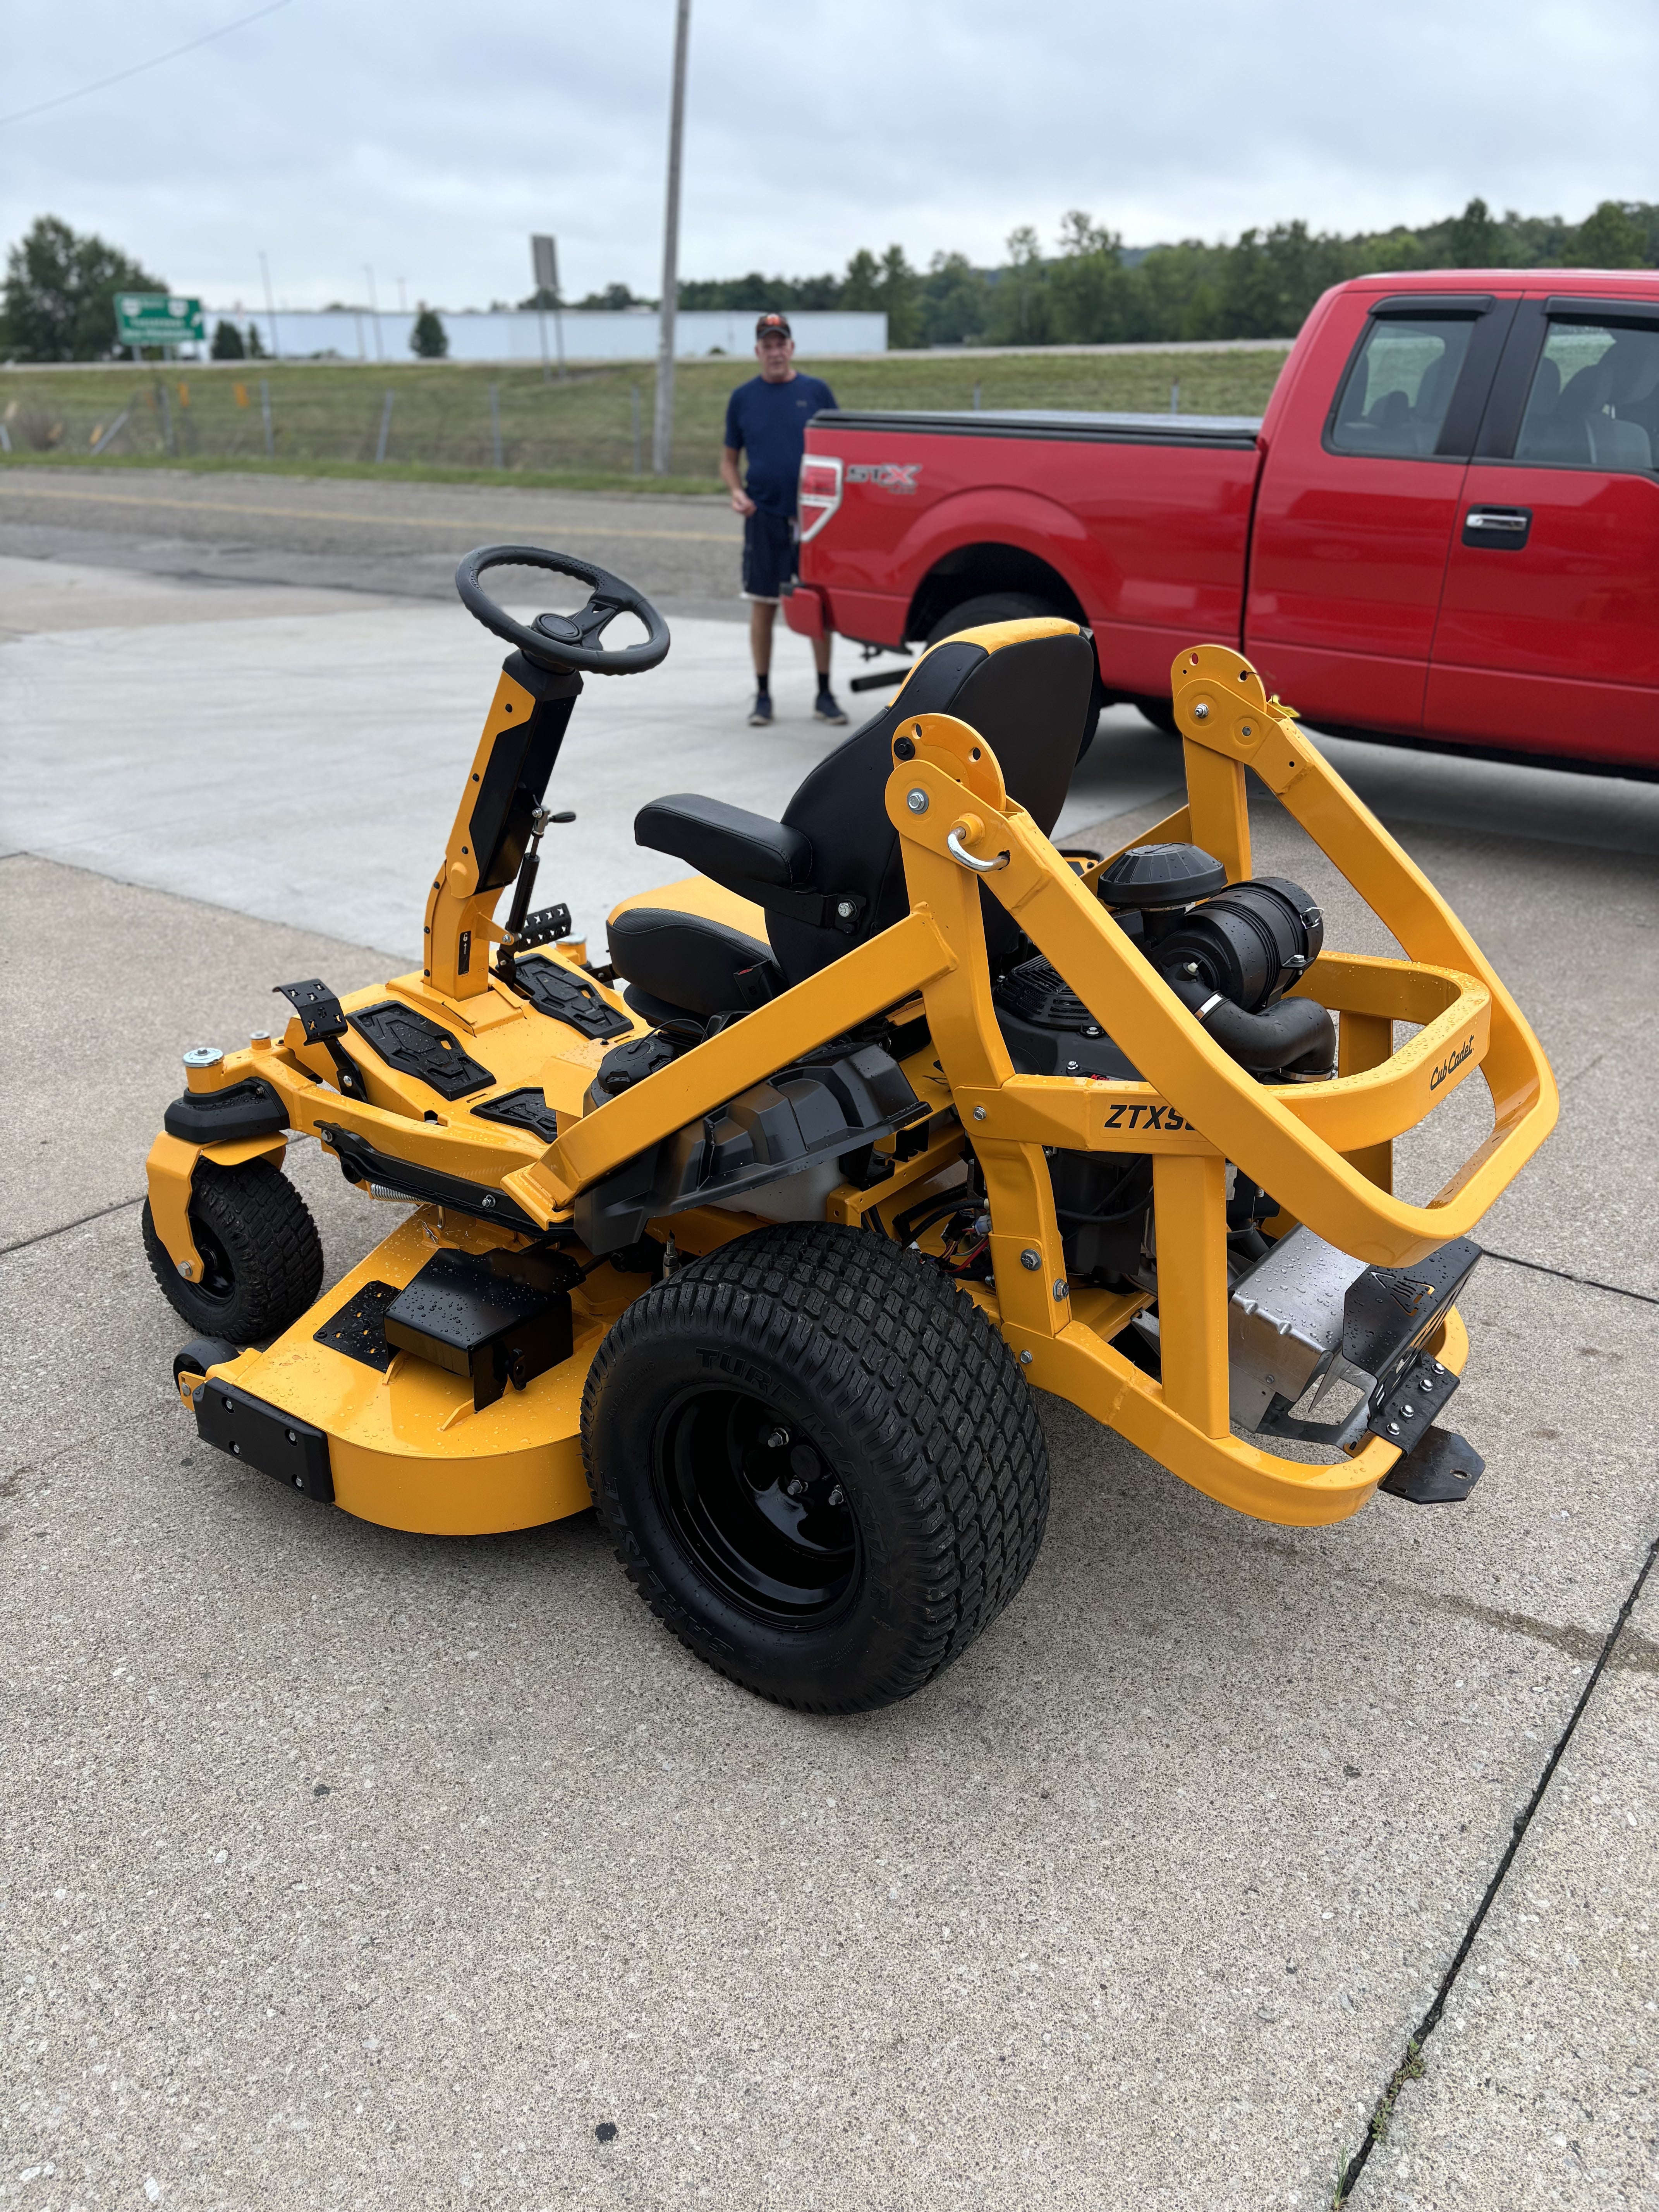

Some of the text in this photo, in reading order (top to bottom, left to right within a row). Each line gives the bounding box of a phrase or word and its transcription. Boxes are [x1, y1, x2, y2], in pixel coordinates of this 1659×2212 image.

[846, 464, 922, 487] STX
[1430, 1035, 1474, 1091] Cub Cadet
[696, 1346, 800, 1403] TURF
[600, 1471, 734, 1657] CARLISLE
